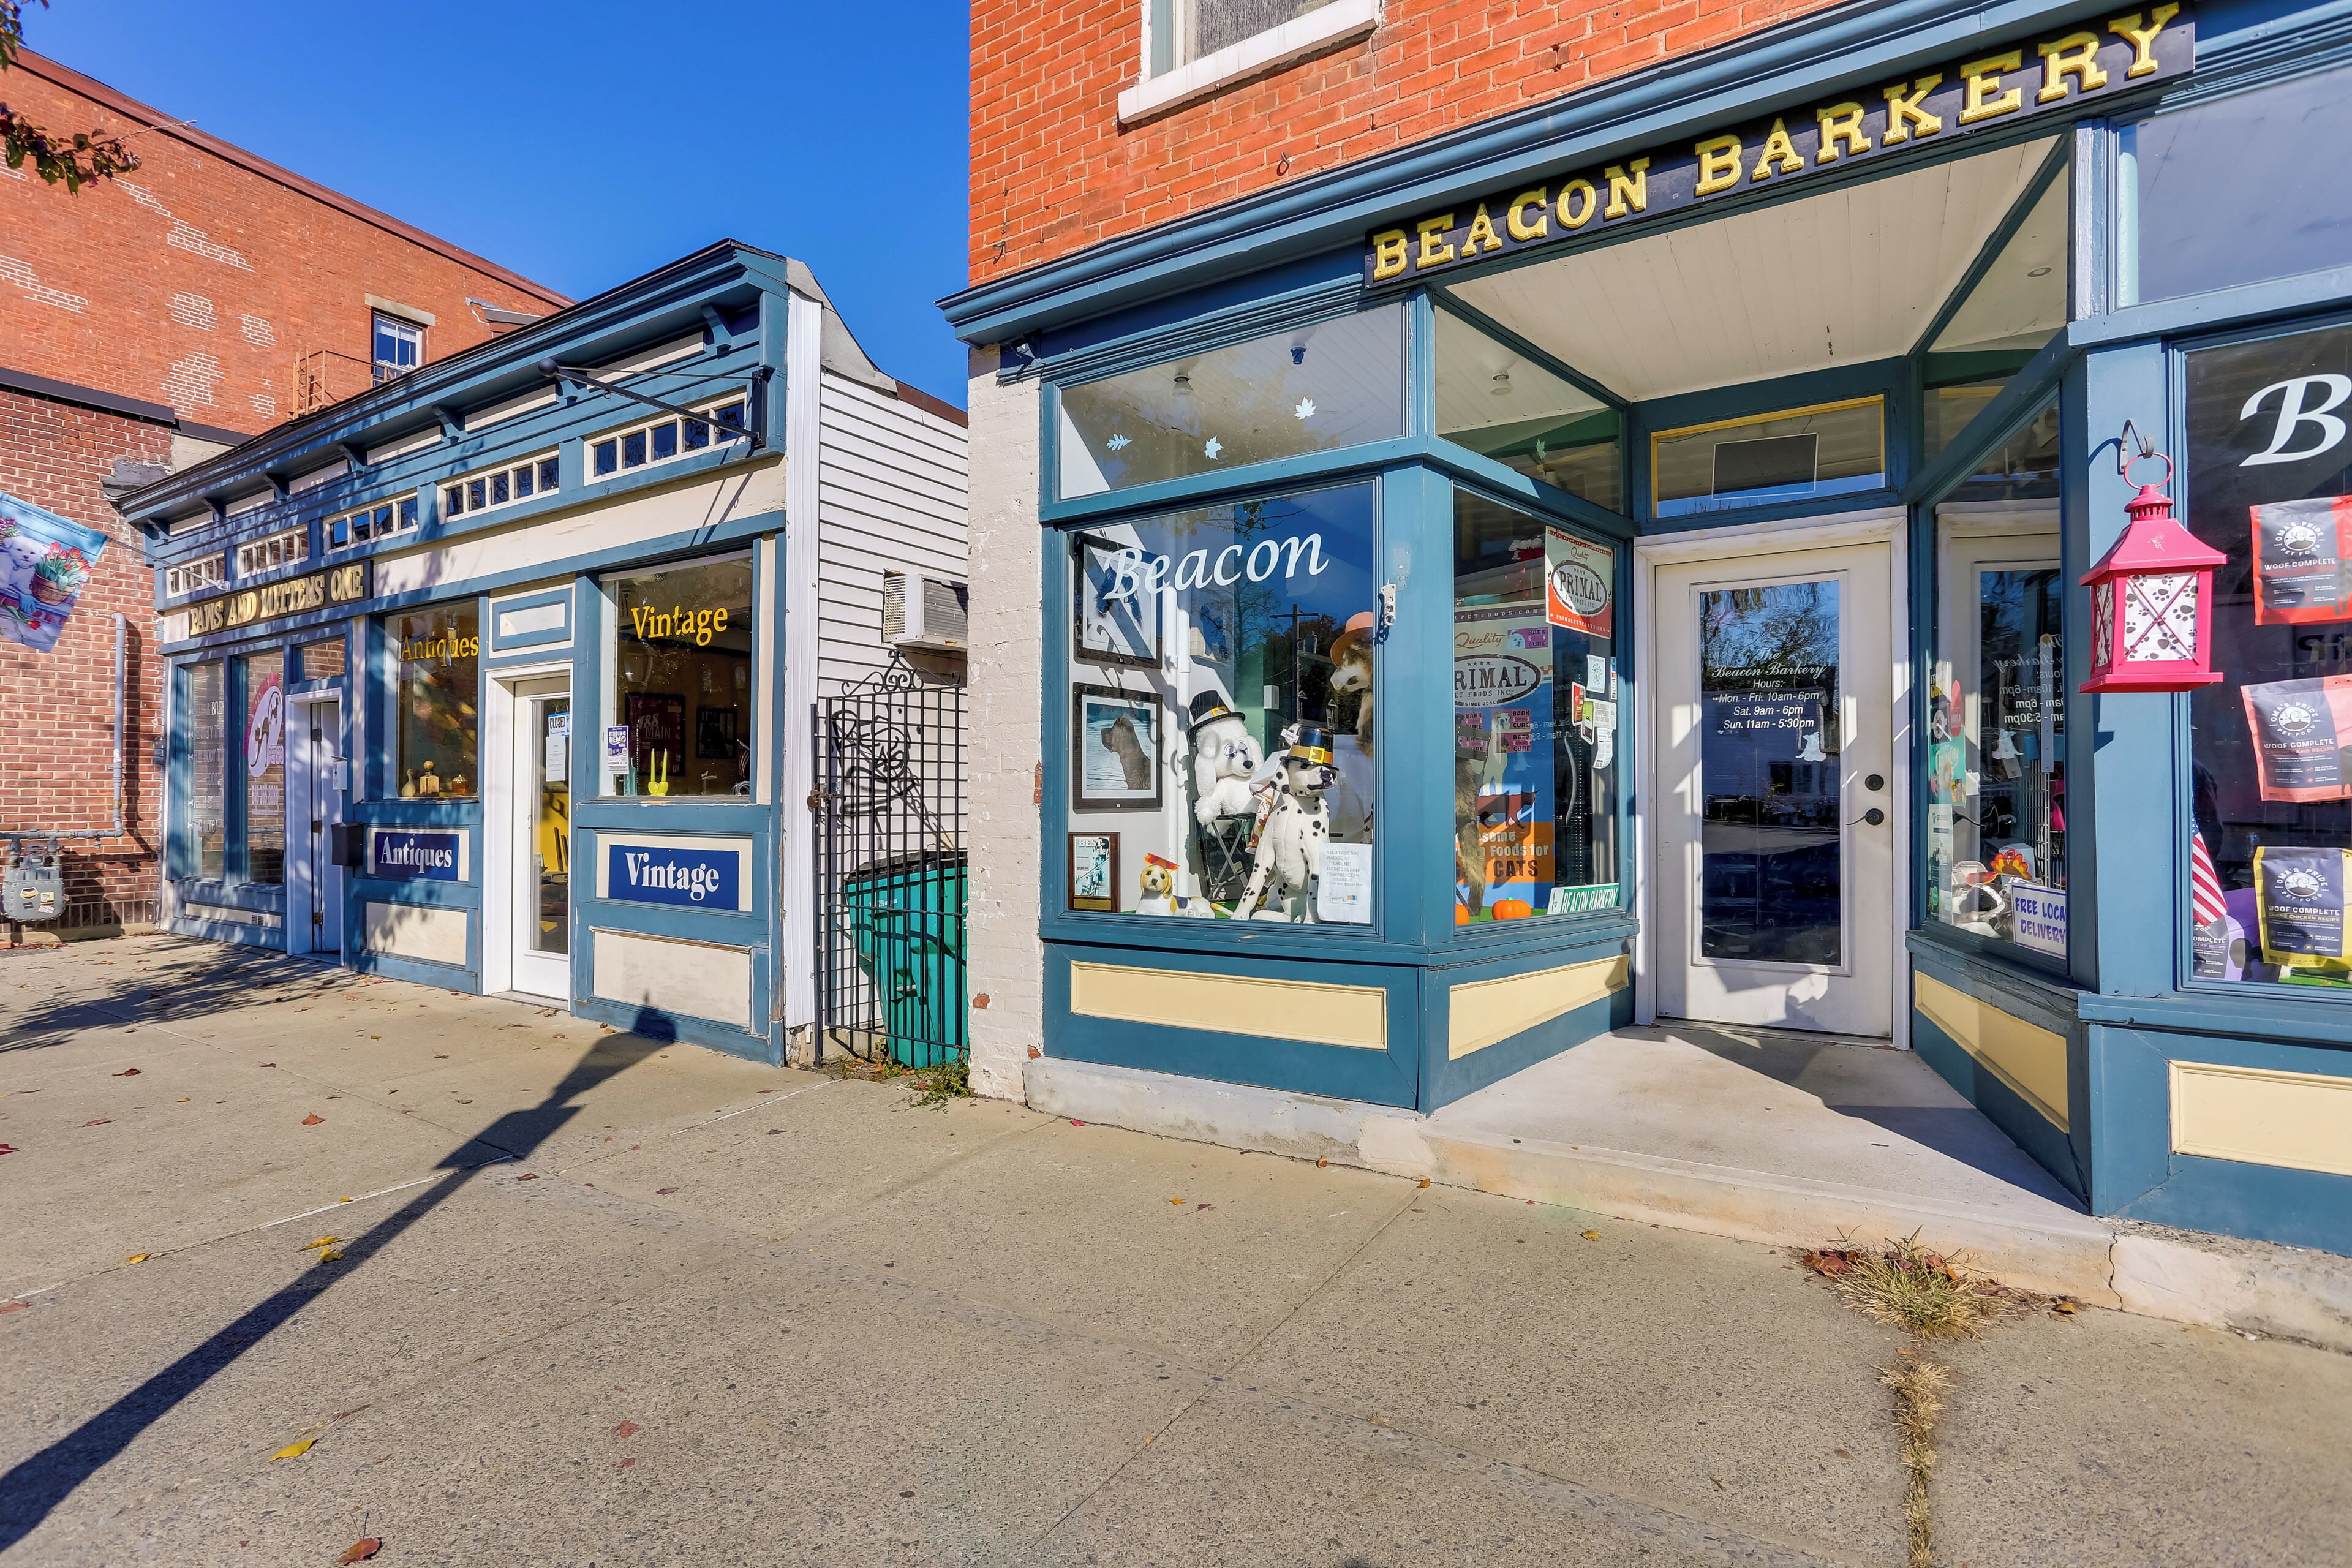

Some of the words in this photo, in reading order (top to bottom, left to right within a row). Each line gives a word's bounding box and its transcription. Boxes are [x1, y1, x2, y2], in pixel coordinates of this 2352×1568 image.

[1371, 157, 1653, 283] BEACON
[1692, 2, 2180, 198] BARKERY
[2301, 521, 2324, 537] PRIDE
[1571, 546, 1589, 562] Quality
[1102, 533, 1329, 600] Beacon
[2264, 562, 2290, 570] WOOF
[2292, 558, 2336, 567] COMPLETE
[1559, 570, 1602, 603] PRIMAL
[190, 600, 224, 636] PAWS
[227, 592, 257, 626] AND
[260, 574, 325, 619] MITTENS
[331, 564, 364, 602] ONE
[630, 605, 728, 646] Vintage
[1455, 631, 1506, 649] Quality
[400, 631, 479, 667] Antiques
[1754, 647, 1784, 660] The
[1455, 666, 1527, 690] RIMAL
[1712, 665, 1764, 678] Beacon
[1765, 662, 1828, 679] Barkery
[1719, 693, 1741, 703] Mon.
[1733, 706, 1751, 715] Sat.
[1754, 706, 1774, 715] 9am
[1782, 705, 1804, 716] 6pm
[2295, 701, 2319, 717] PRIDE
[549, 717, 565, 729] CLOSED
[1724, 720, 1743, 729] Sun.
[1746, 719, 1770, 729] 11am
[1778, 718, 1814, 730] 5:30pm
[2295, 725, 2315, 736] FOOD
[645, 726, 671, 739] MAIN
[2290, 738, 2334, 748] COMPLETE
[380, 836, 452, 873] Antiques
[1490, 843, 1526, 857] Foods
[1530, 843, 1549, 856] for
[625, 852, 720, 902] Vintage
[1493, 859, 1539, 878] CATS
[2305, 868, 2328, 886] PRIDE
[1562, 891, 1589, 913] BEACON
[1588, 888, 1618, 910] BARKERY
[2281, 891, 2296, 900] PET
[2299, 893, 2323, 902] FOOD
[2015, 897, 2038, 916] FREE
[2042, 902, 2065, 922] LOCA
[2293, 907, 2340, 916] COMPLETE
[2020, 919, 2067, 944] DELIVERY
